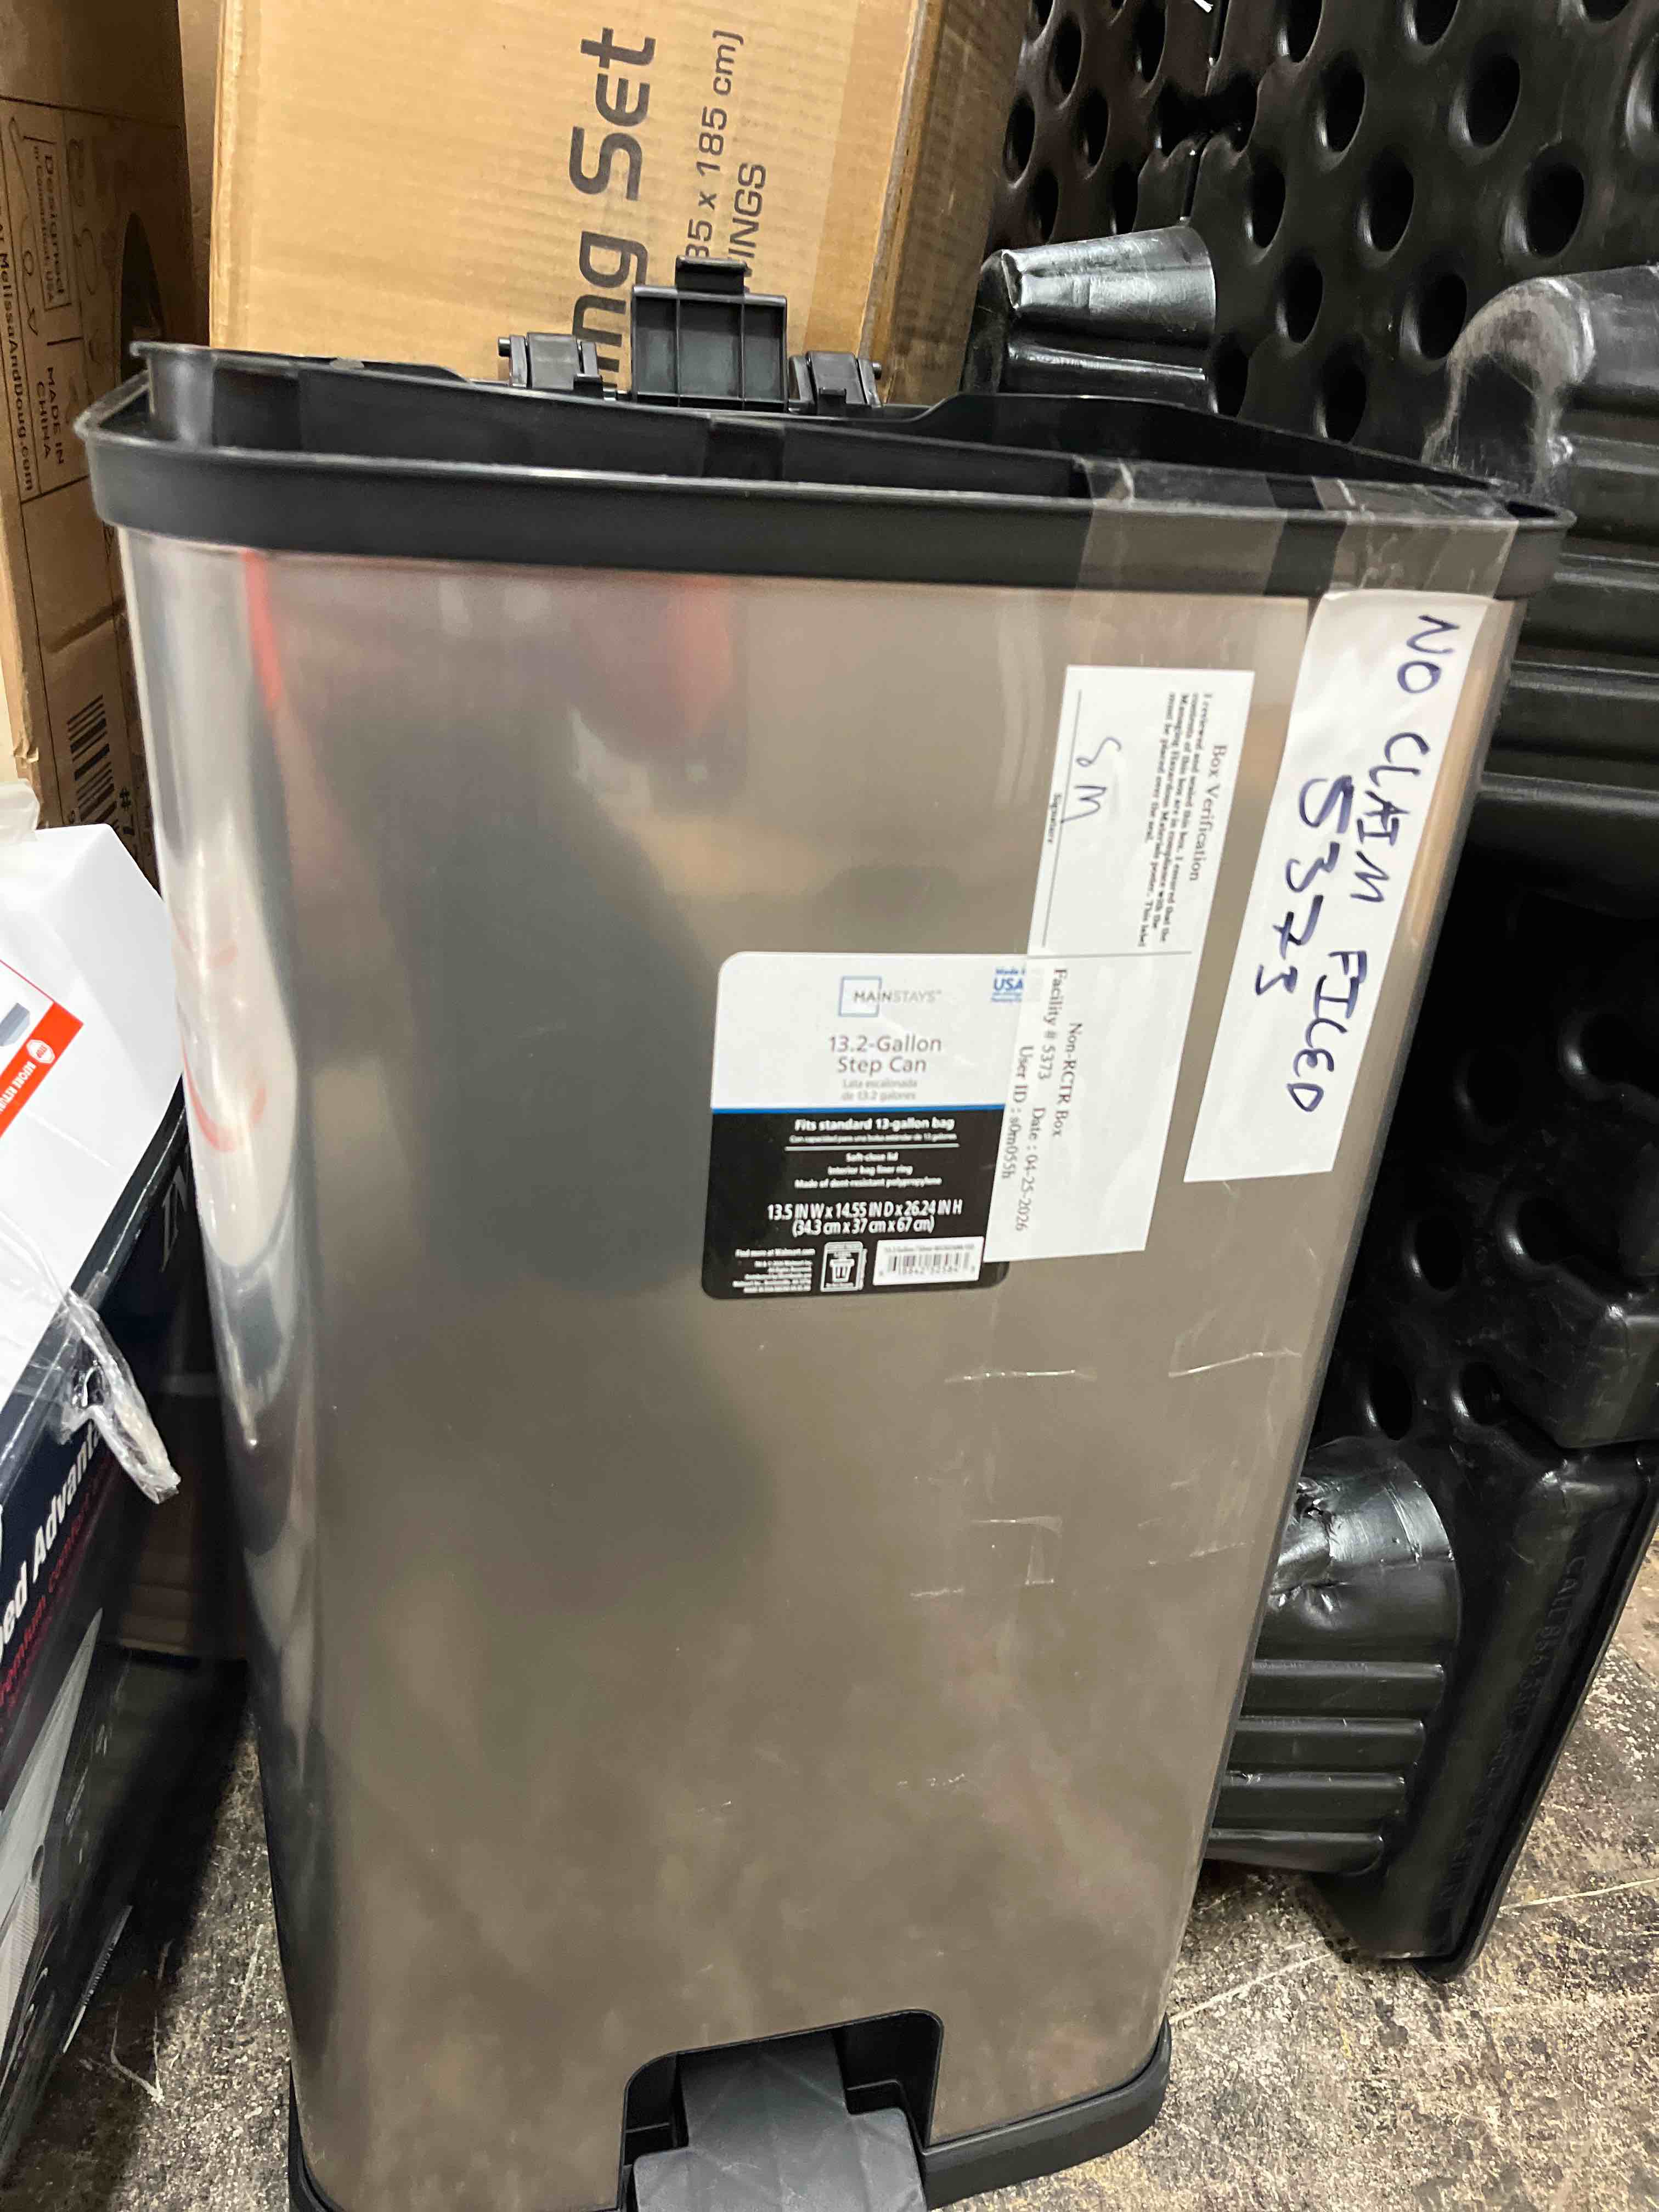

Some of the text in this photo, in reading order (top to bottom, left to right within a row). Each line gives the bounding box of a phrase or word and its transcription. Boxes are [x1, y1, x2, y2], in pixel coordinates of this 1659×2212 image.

[568, 26, 657, 202] Set
[696, 105, 728, 176] 185
[698, 190, 717, 211] x
[37, 381, 52, 460] CHINA
[47, 367, 65, 465] MADE IN
[1397, 614, 1462, 695] NO
[1188, 744, 1227, 881] Box Verification
[1351, 731, 1431, 904] CLAIM
[1254, 774, 1354, 997] 5373
[993, 977, 1024, 991] USA
[1043, 968, 1068, 1026] Facility
[829, 1034, 943, 1053] 13.2-Gallon
[837, 1055, 928, 1077] Step Can
[1016, 1045, 1035, 1080] User
[1037, 1044, 1056, 1081] 5373
[1013, 1085, 1029, 1103] ID
[1052, 1022, 1084, 1137] Non-RCTR Box
[795, 1116, 956, 1132] Fits standard 13-gallon bag
[1028, 1107, 1046, 1141] Date
[768, 1203, 793, 1221] 13.5
[794, 1203, 809, 1220] IN
[810, 1202, 825, 1219] W
[825, 1205, 834, 1219] x
[835, 1201, 867, 1219] 14.55
[868, 1201, 882, 1218] IN
[884, 1200, 894, 1218] D
[894, 1204, 904, 1217] x
[937, 1199, 952, 1216] IN
[952, 1198, 963, 1216] H
[1014, 1154, 1039, 1232] 04-25-2026
[792, 1214, 935, 1238] (34.3 cm x 37 cm x 67 cm)
